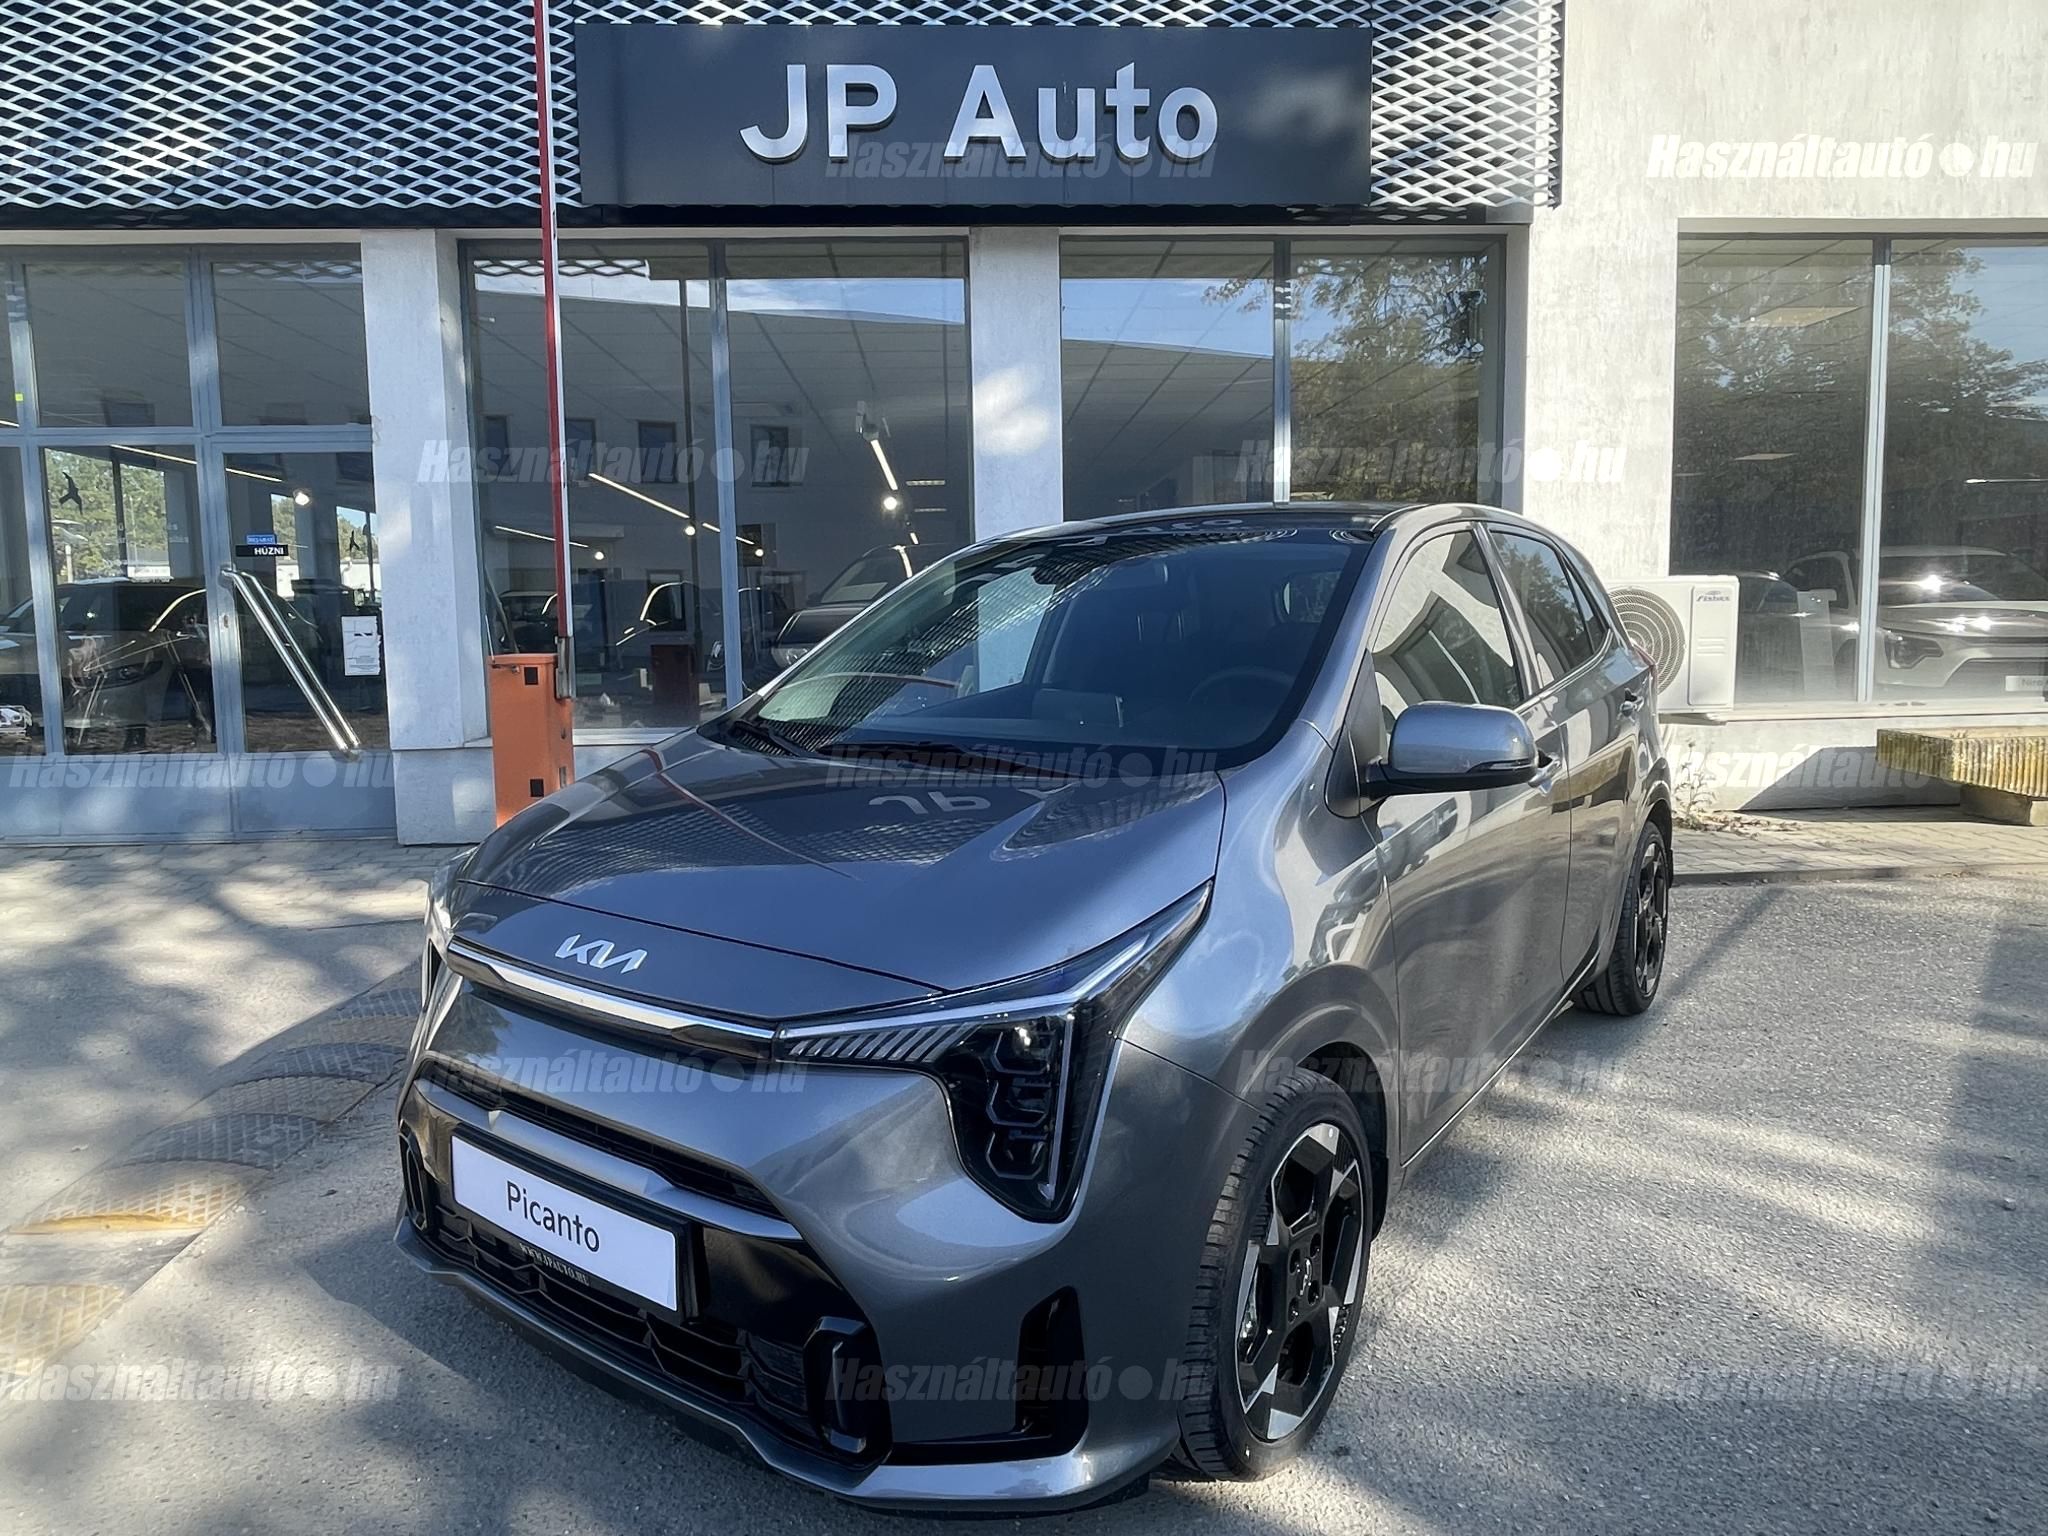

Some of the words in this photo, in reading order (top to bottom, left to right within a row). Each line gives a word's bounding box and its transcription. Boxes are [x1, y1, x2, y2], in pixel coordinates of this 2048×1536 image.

[739, 63, 898, 161] JP
[943, 61, 1219, 160] Auto
[254, 546, 284, 555] HÚZNI
[506, 1180, 600, 1252] Picanto
